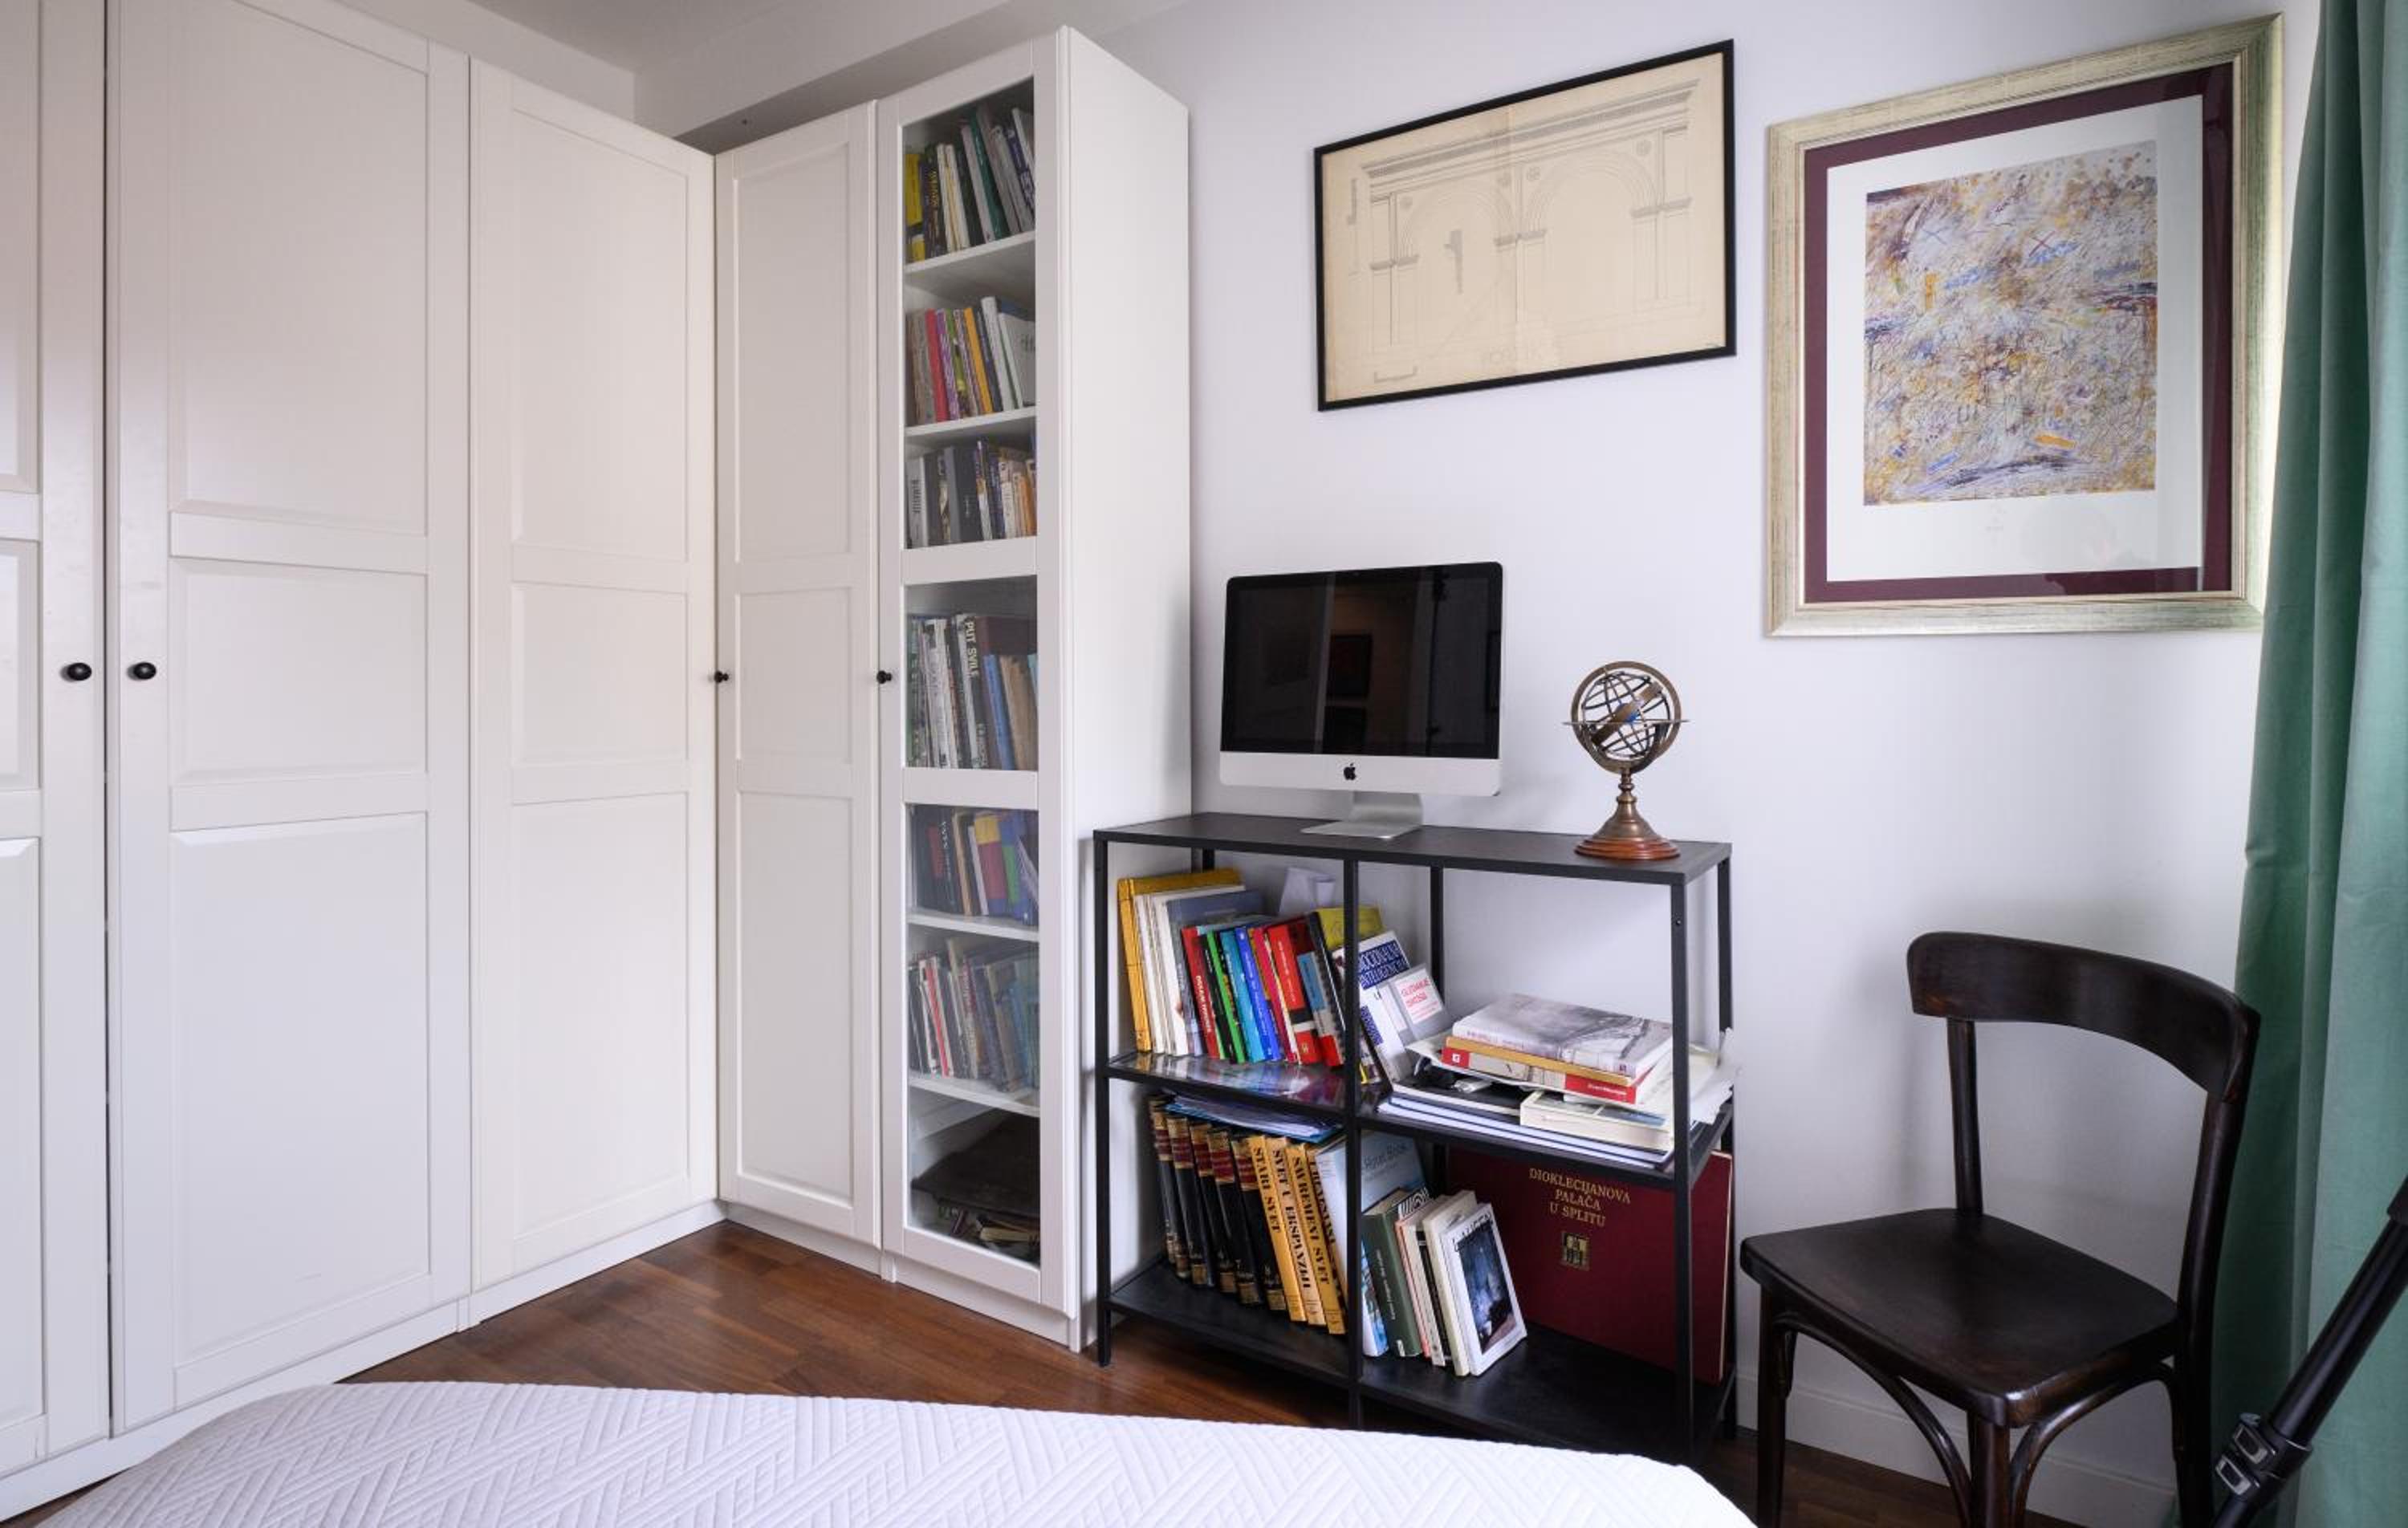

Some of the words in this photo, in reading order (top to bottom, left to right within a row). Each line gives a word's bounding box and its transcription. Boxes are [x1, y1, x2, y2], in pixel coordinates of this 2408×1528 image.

[965, 622, 976, 642] PUT
[1254, 1148, 1271, 1189] STARI
[1265, 1197, 1281, 1232] SVET
[1529, 1168, 1631, 1204] DIOKLECIJANOVA
[1555, 1189, 1601, 1211] PALAČA
[1273, 1149, 1287, 1183] SVET
[1286, 1206, 1311, 1288] EKSPANZIJI
[1293, 1156, 1320, 1240] SAVREMENI
[1313, 1247, 1329, 1284] SVET
[1550, 1201, 1558, 1214] U
[1562, 1205, 1605, 1227] SPLITU
